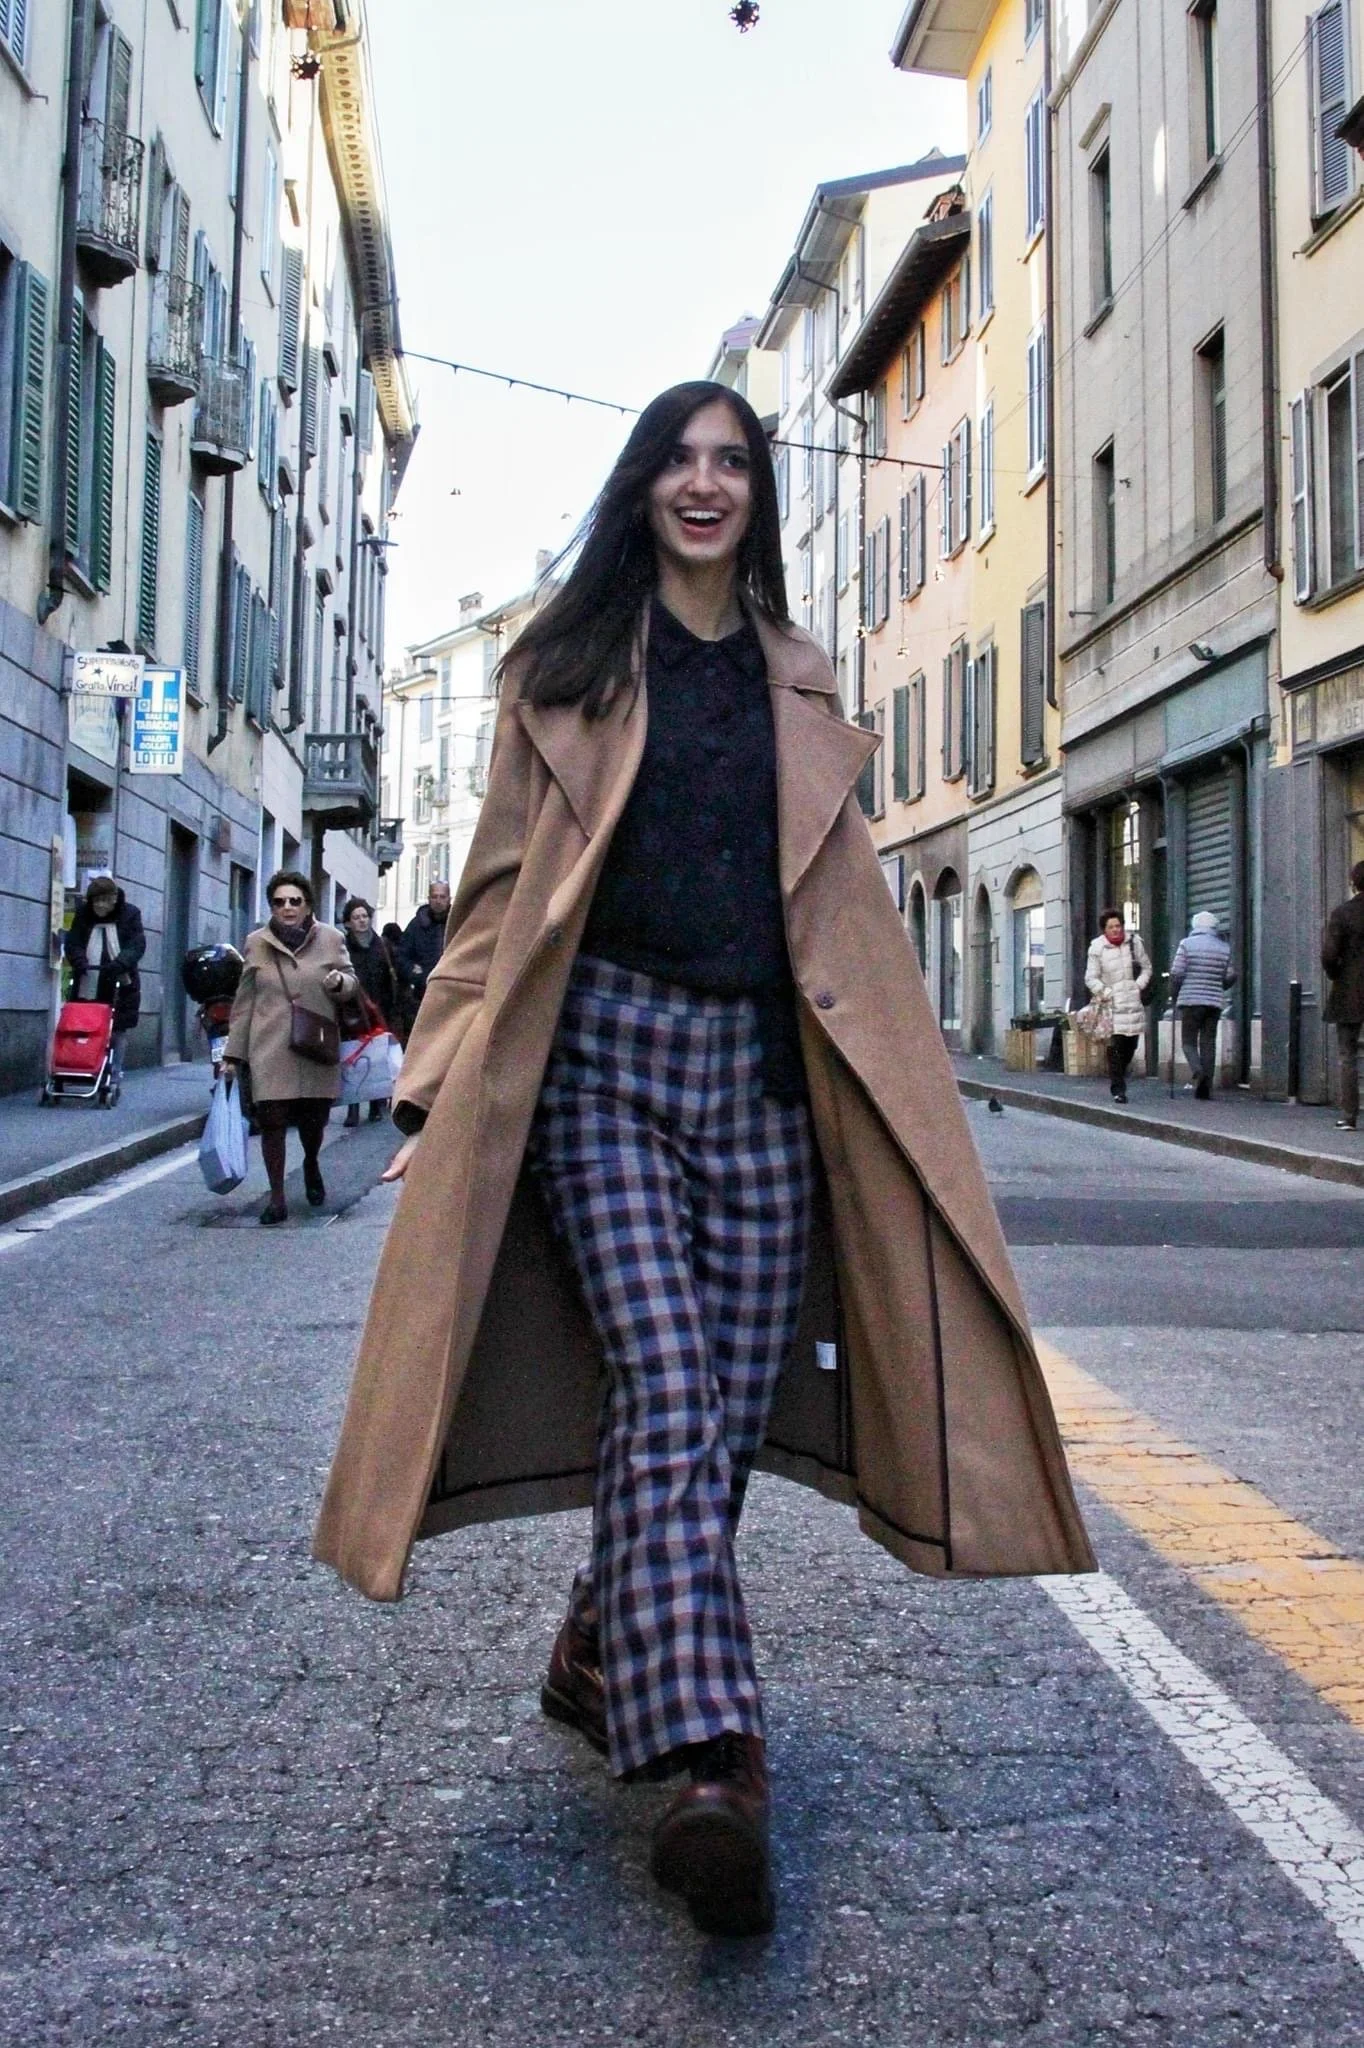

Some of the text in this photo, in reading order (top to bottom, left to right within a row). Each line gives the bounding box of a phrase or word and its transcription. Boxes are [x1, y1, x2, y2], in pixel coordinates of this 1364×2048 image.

[106, 673, 138, 692] Vinci!
[135, 720, 179, 730] TABACCHI
[135, 752, 175, 765] LOTTO
